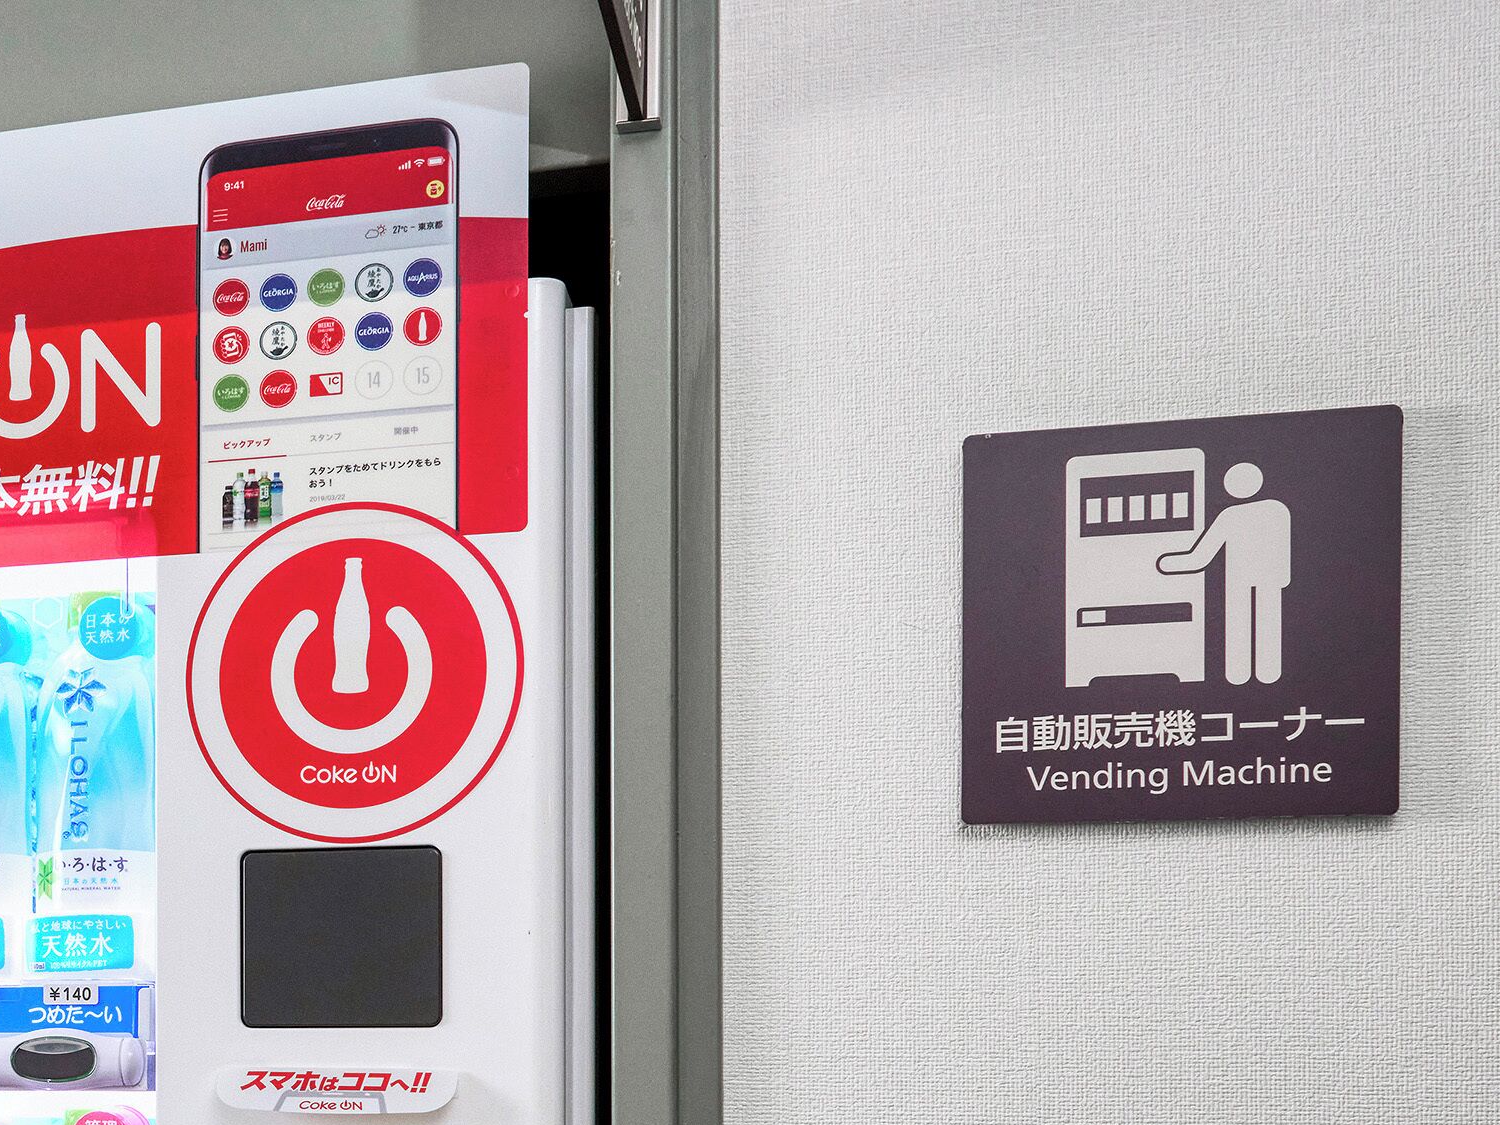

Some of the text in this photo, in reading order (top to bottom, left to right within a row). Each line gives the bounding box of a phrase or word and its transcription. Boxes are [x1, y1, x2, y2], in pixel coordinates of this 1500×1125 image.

[224, 180, 245, 191] 9:41
[240, 238, 268, 253] Mami
[329, 376, 339, 385] IC
[368, 372, 380, 388] 14
[417, 367, 429, 384] 15
[223, 438, 271, 450] ピックアップ
[310, 432, 342, 442] スタンプ
[86, 628, 130, 645] 天然水
[995, 706, 1365, 753] 自動販売機コーナー
[300, 765, 357, 784] Coke
[1027, 756, 1333, 795] Vending Machine
[42, 932, 113, 958] 天然水
[49, 987, 91, 1001] ¥140
[299, 1100, 337, 1111] Coke
